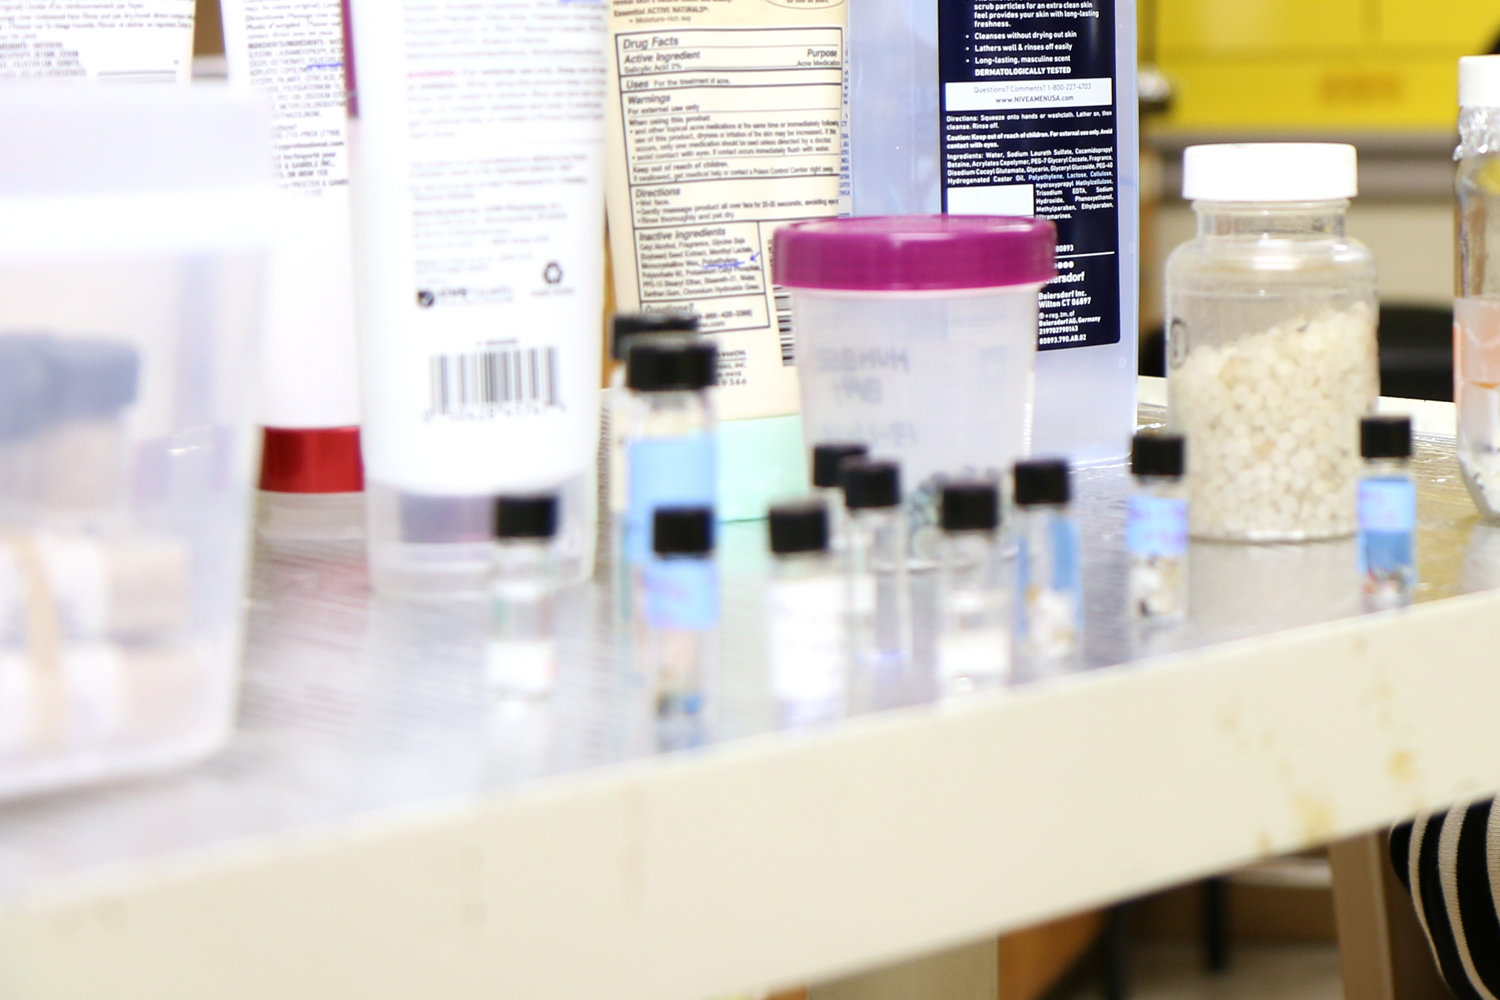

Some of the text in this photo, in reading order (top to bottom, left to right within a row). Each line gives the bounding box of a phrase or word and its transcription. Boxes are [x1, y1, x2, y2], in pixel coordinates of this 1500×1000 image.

[995, 2, 1026, 10] particles
[974, 11, 988, 19] feel
[989, 11, 1019, 19] provides
[1035, 10, 1049, 18] skin
[1064, 10, 1099, 19] long-lasting
[974, 20, 1011, 28] freshness.
[974, 32, 1006, 40] Cleanses
[1032, 31, 1053, 40] drying
[974, 44, 1002, 52] Lathers
[1054, 43, 1073, 51] easily
[1020, 55, 1053, 63] masculine
[975, 66, 1071, 76] DERMATOLOGICALLY TESTED
[974, 85, 1009, 93] Questions?
[1010, 84, 1046, 92] Comments?
[996, 95, 1074, 103] www.NIVEAMENUSA.com
[980, 114, 1005, 122] Squeeze
[1045, 271, 1085, 284] ersdorf
[1038, 289, 1087, 300] Beiersdorf Inc.
[1038, 299, 1061, 309] Wilton
[1061, 298, 1071, 307] CT
